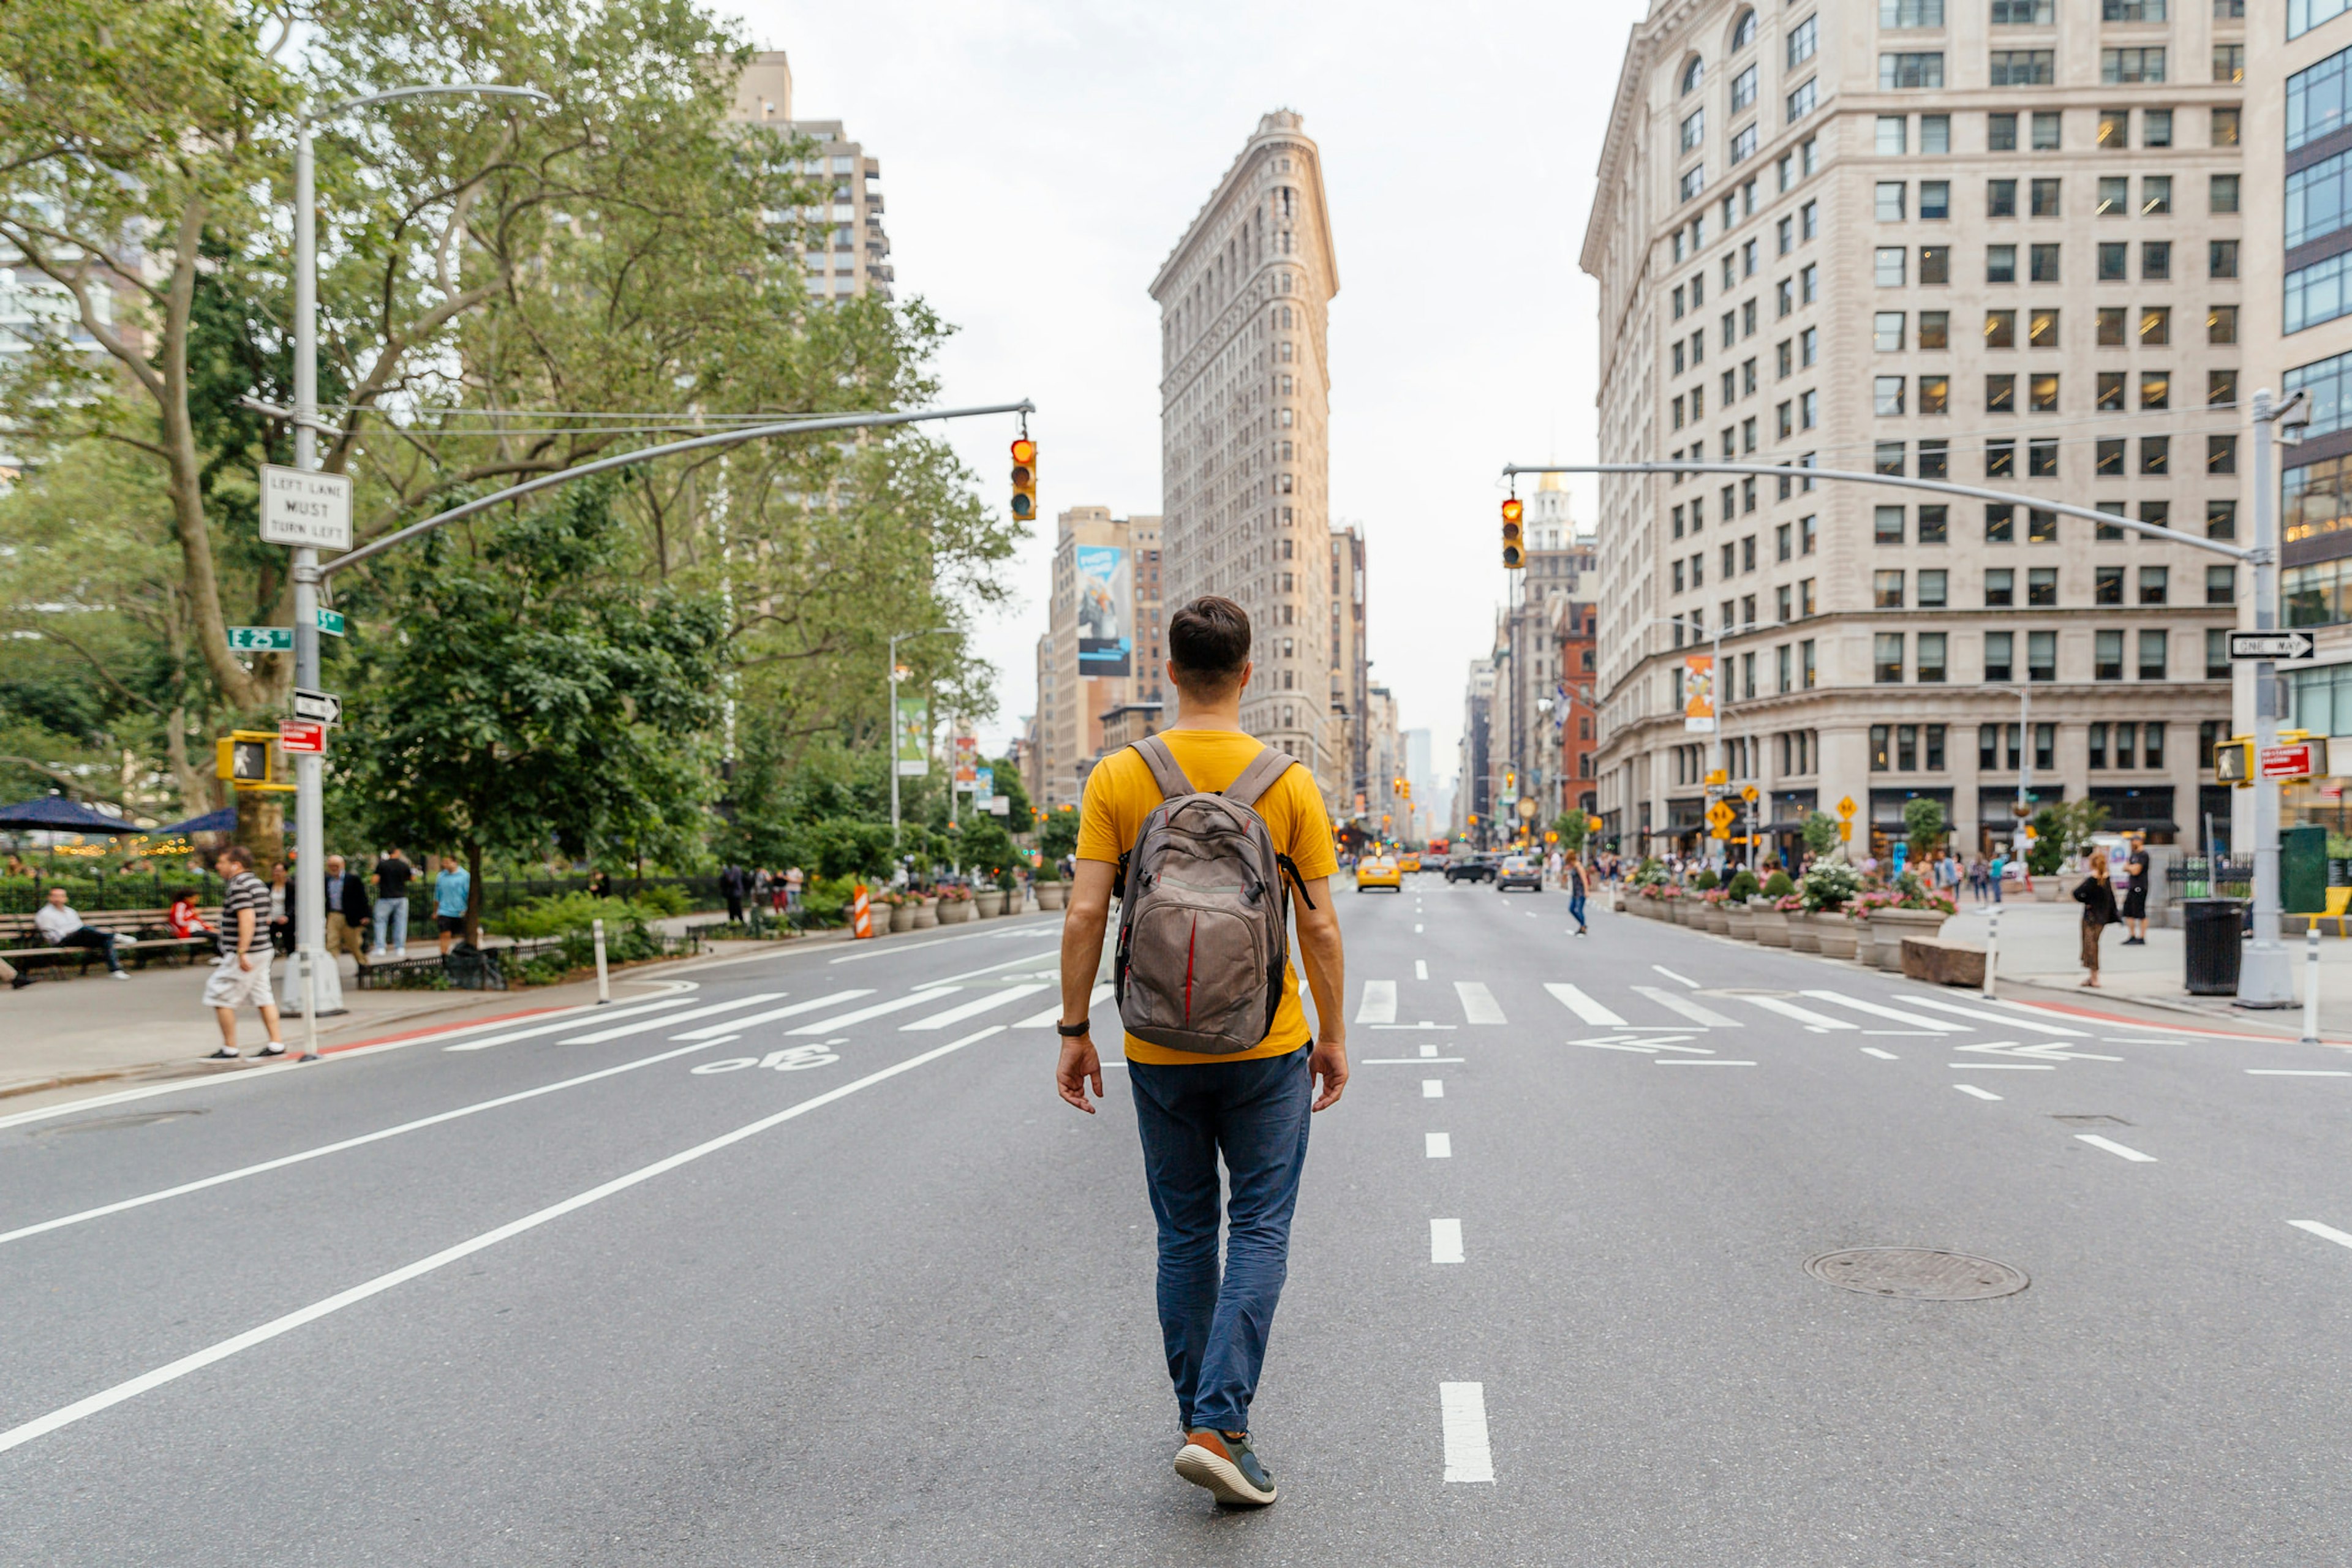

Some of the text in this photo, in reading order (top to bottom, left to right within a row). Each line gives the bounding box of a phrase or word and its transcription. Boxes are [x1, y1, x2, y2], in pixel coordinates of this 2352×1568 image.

[271, 478, 343, 498] LEFT LANE
[284, 500, 329, 519] MUST
[271, 519, 343, 540] TURN LEFT
[232, 629, 244, 647] E
[250, 629, 274, 647] 25
[2239, 639, 2303, 652] ONE WAY
